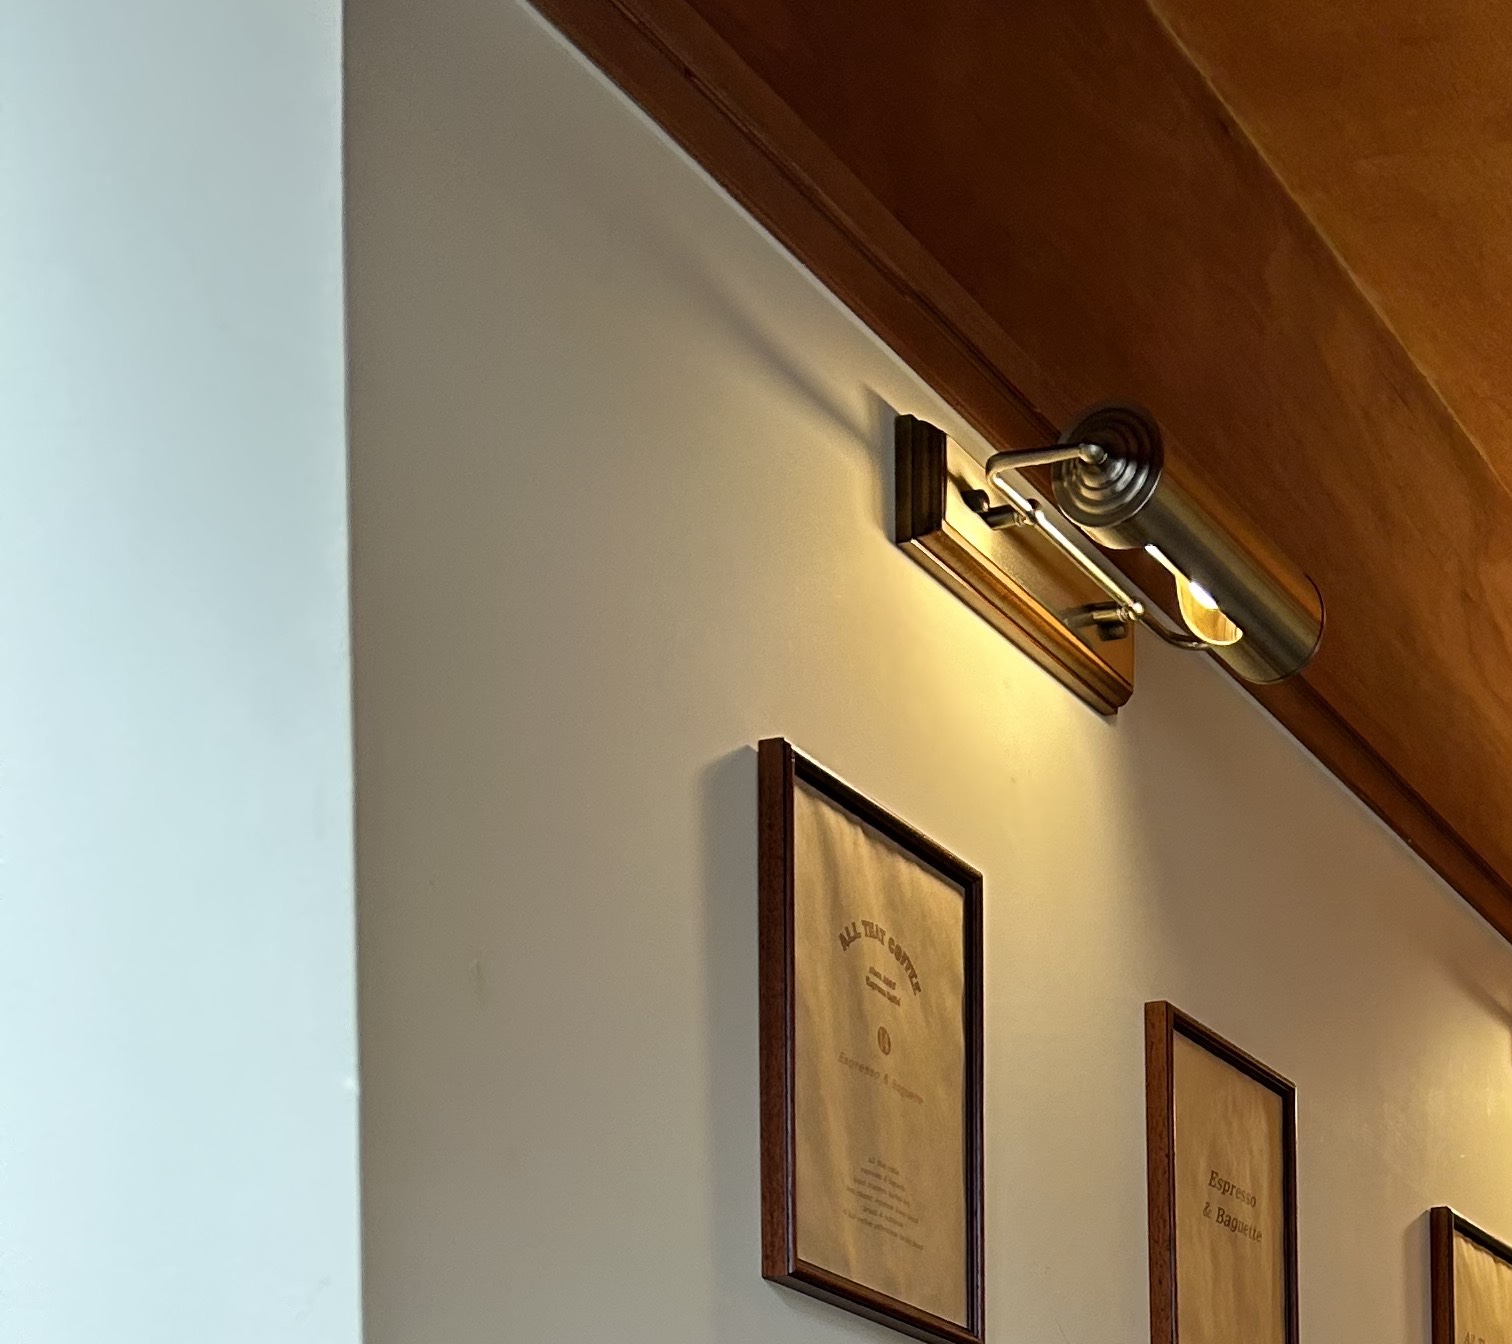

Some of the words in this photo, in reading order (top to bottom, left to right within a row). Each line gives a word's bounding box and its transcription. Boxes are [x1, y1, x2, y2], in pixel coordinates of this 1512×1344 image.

[839, 923, 861, 951] ALL
[1208, 1169, 1257, 1208] Espresso
[1202, 1201, 1212, 1219] &
[1215, 1206, 1262, 1243] Baguette
